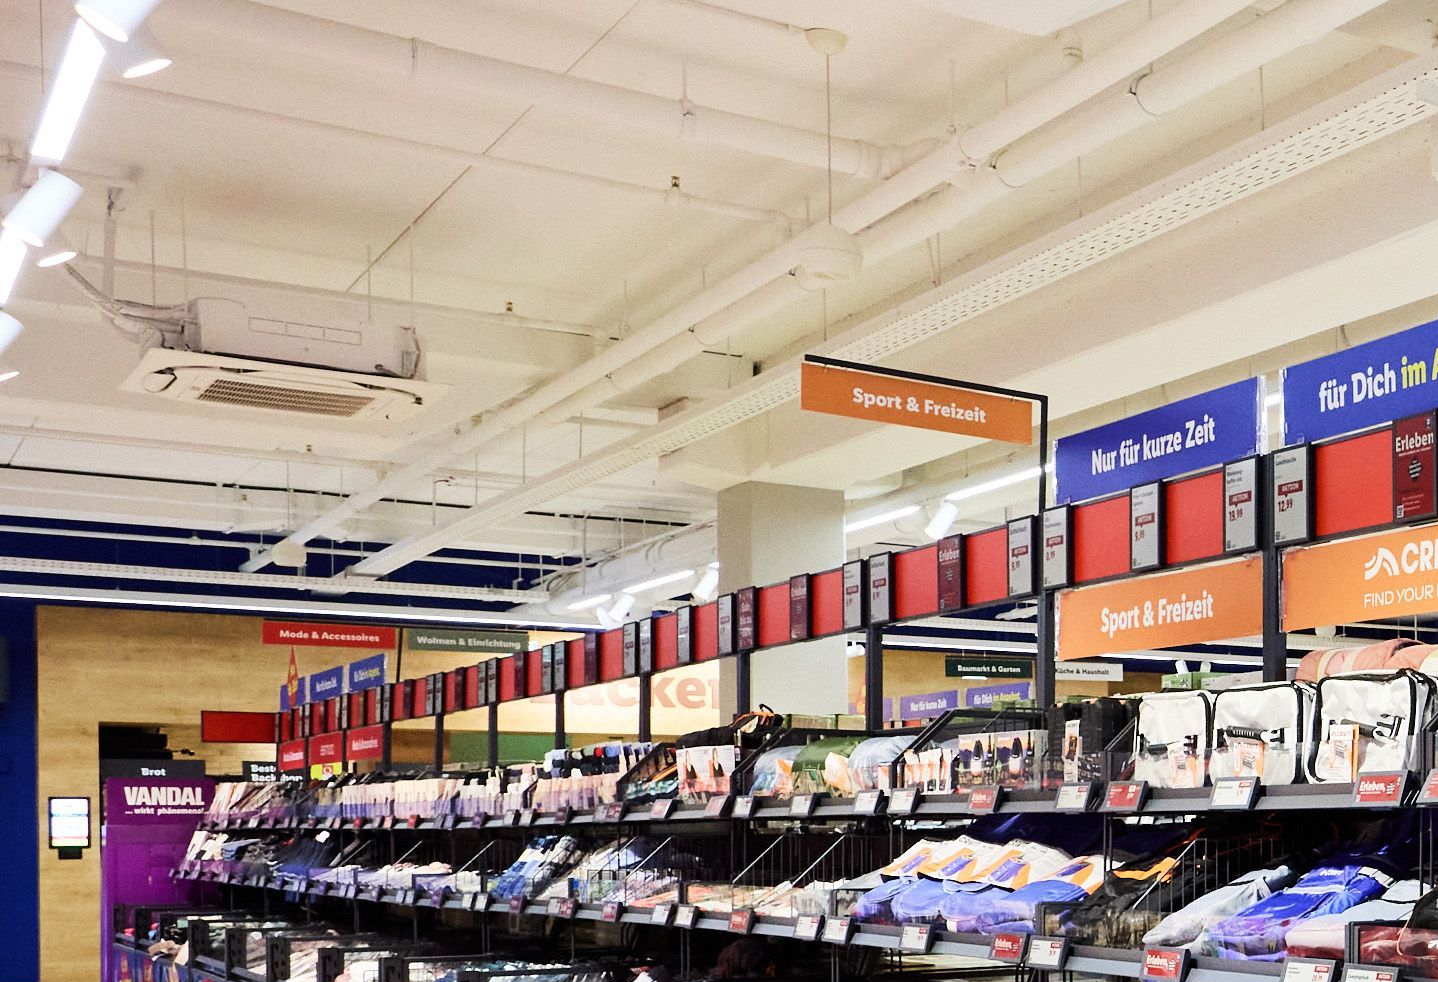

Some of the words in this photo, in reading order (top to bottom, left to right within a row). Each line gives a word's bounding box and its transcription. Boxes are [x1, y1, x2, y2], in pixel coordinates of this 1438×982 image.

[1319, 380, 1347, 412] für
[1352, 363, 1397, 402] Dich
[1401, 356, 1427, 389] im
[853, 388, 902, 410] Sport
[906, 399, 919, 412] &
[924, 400, 986, 423] Freizeit
[1092, 448, 1117, 475] Nur
[1120, 440, 1141, 466] für
[1142, 432, 1182, 456] kurze
[1186, 414, 1215, 446] Zeit
[1396, 431, 1434, 453] Erleben
[1364, 591, 1394, 608] FIND
[1397, 585, 1435, 602] YOUR
[1101, 604, 1139, 638] Sport
[1143, 601, 1154, 626] &
[1158, 590, 1214, 622] Freizeit
[280, 629, 309, 639] Mode
[310, 631, 319, 639] &
[321, 631, 380, 642] Accessoires
[417, 636, 456, 645] Wohnen
[458, 638, 465, 646] &
[467, 638, 521, 649] Einrichtung
[958, 664, 990, 673] Baumarkt
[141, 768, 166, 776] Brot
[124, 786, 205, 806] VANDAL
